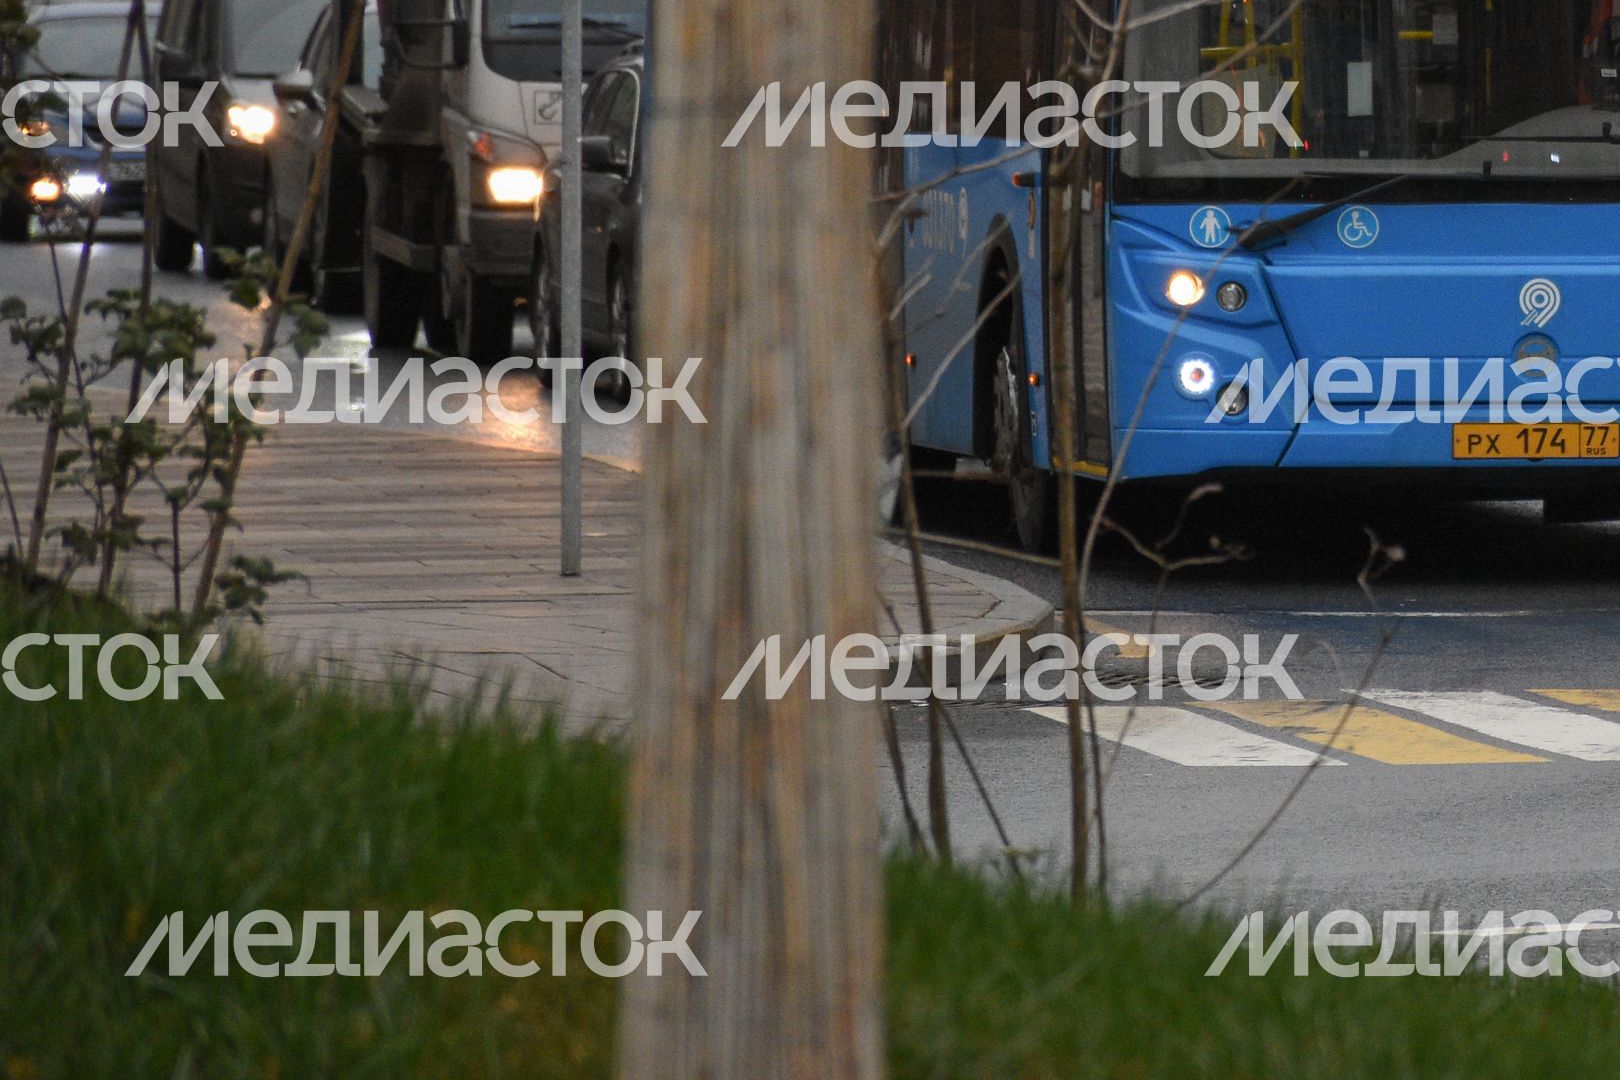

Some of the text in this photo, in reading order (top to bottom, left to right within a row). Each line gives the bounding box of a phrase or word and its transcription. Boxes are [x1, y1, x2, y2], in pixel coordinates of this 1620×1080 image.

[1516, 427, 1567, 454] 174
[1583, 426, 1610, 446] 77
[1586, 447, 1607, 455] RUS
